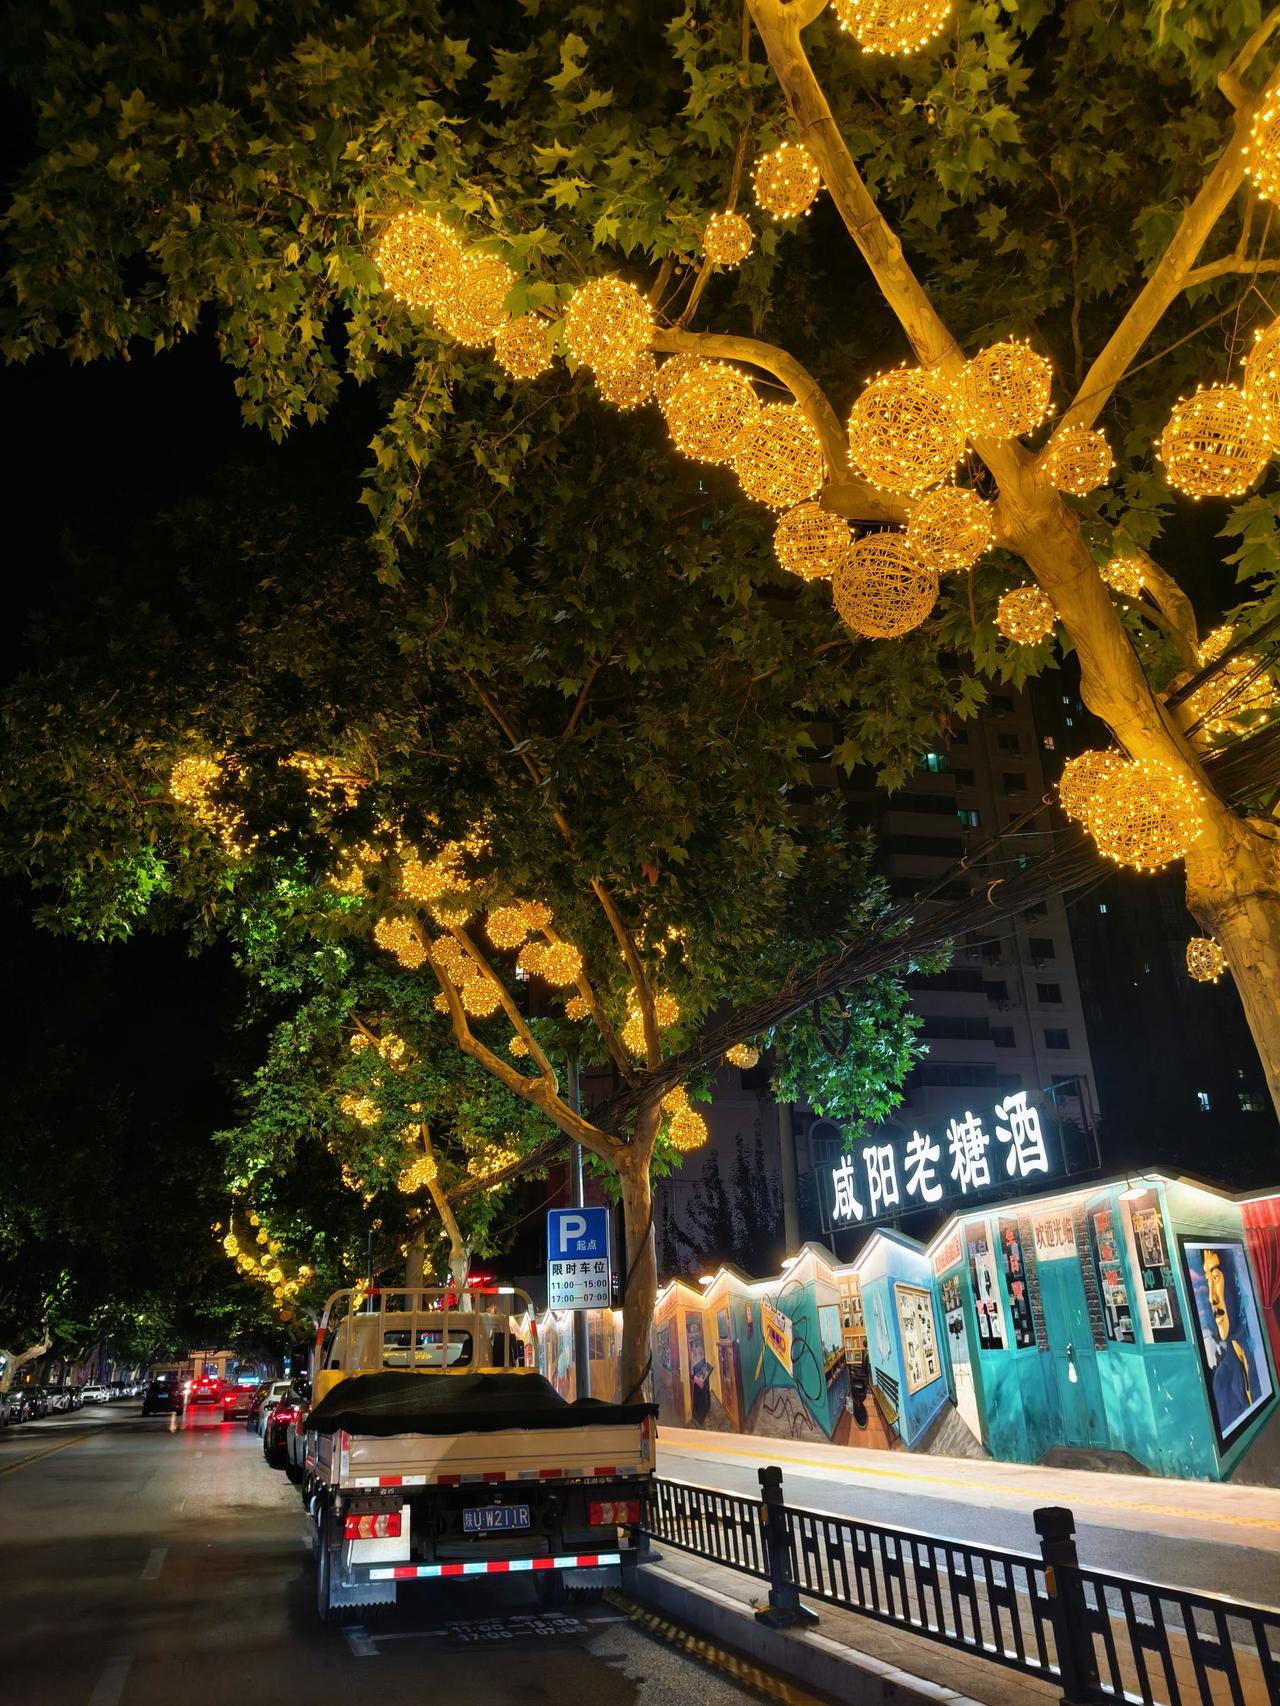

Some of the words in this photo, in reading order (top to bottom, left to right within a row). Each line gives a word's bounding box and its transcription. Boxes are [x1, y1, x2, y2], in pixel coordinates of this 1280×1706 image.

[832, 1090, 1049, 1221] 咸阳老糖酒
[560, 1215, 587, 1253] P
[576, 1239, 598, 1251] 起点
[1034, 1216, 1074, 1250] 欢迎光临
[552, 1261, 606, 1276] 限时车位
